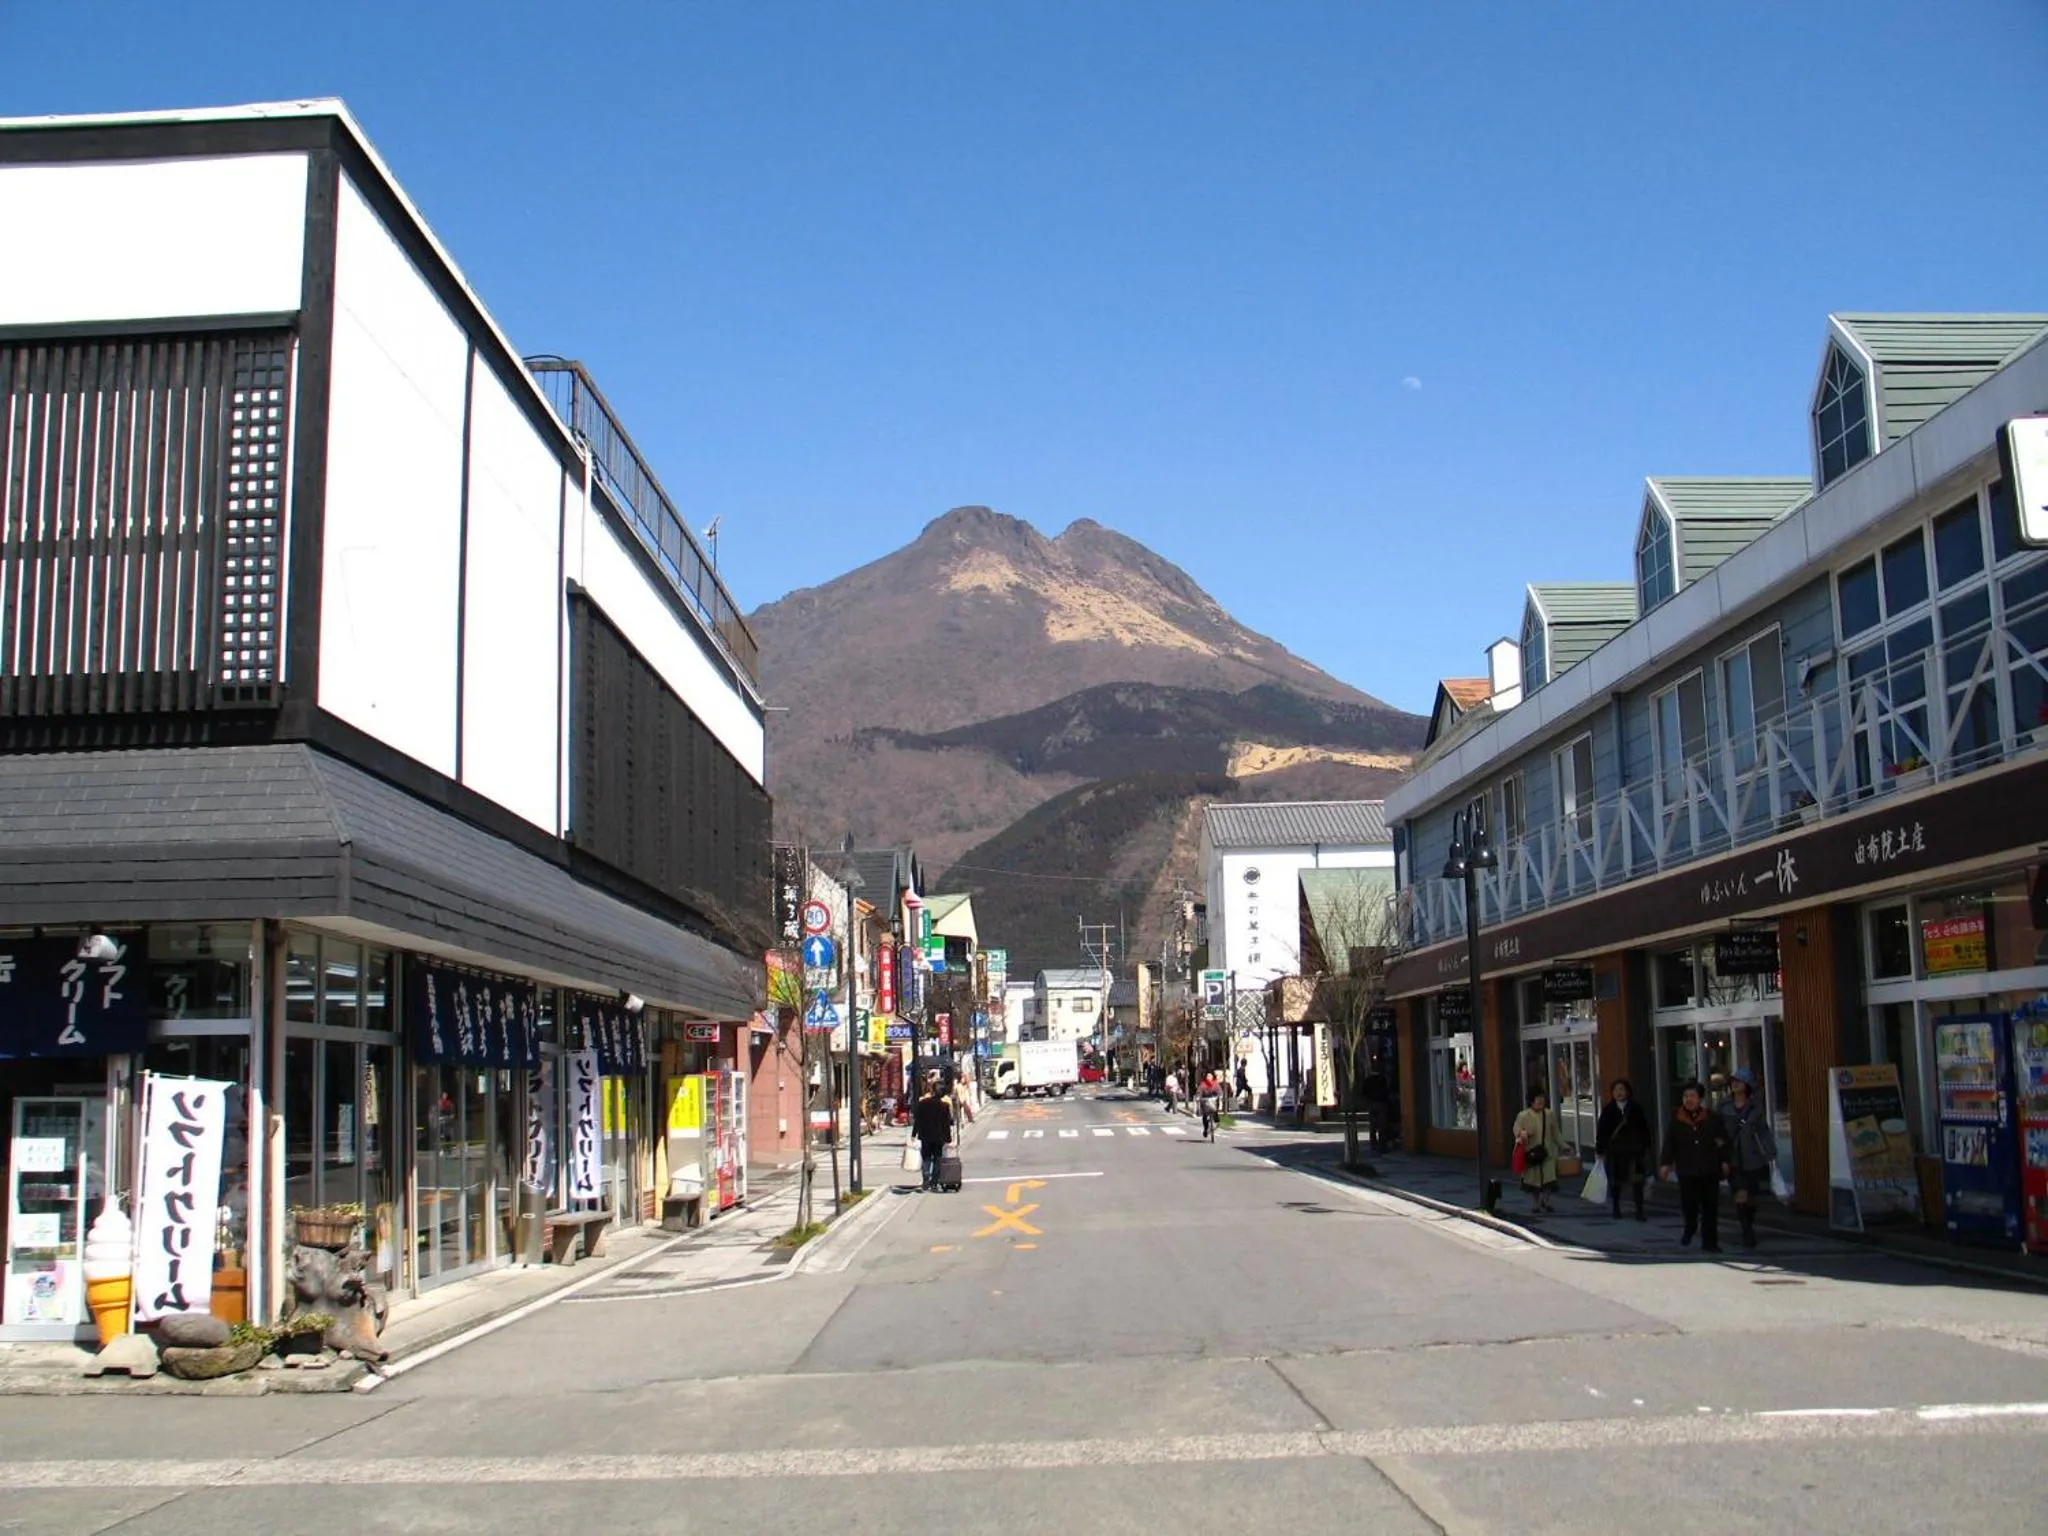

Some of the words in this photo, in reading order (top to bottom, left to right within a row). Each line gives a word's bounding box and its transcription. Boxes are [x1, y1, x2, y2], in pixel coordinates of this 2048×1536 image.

[1854, 821, 1927, 865] 由布院土産
[1700, 872, 1748, 905] ゆふいん
[1754, 848, 1799, 894] 一休
[58, 958, 87, 1045] クリーム
[1206, 983, 1222, 1004] P
